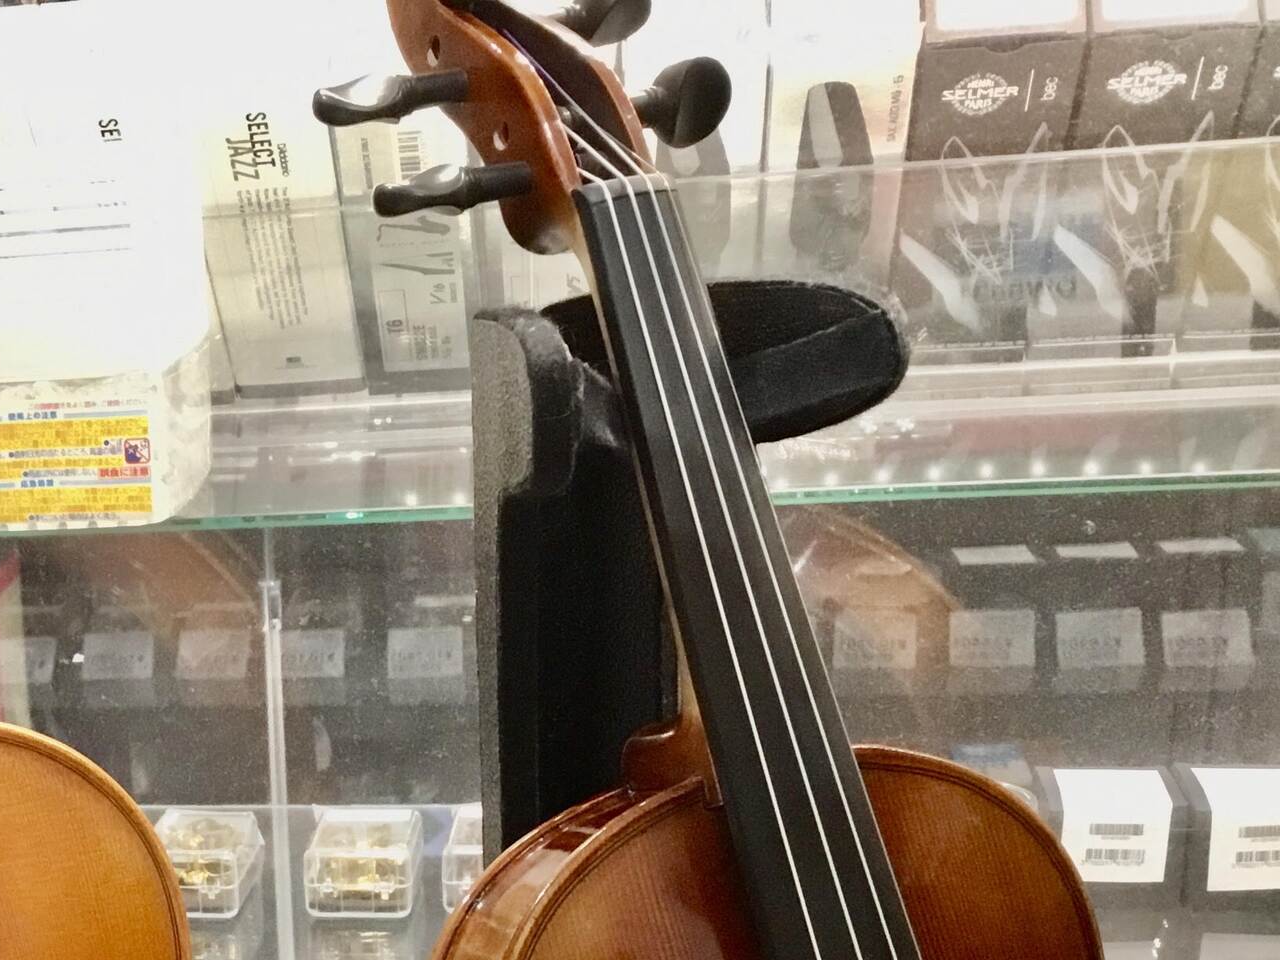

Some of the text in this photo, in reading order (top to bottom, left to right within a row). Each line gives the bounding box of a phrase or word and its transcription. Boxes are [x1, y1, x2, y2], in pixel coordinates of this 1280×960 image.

[940, 85, 1020, 102] SELMER
[1105, 72, 1188, 91] SELMER
[245, 111, 276, 168] SELECT
[224, 137, 261, 182] JAZZ
